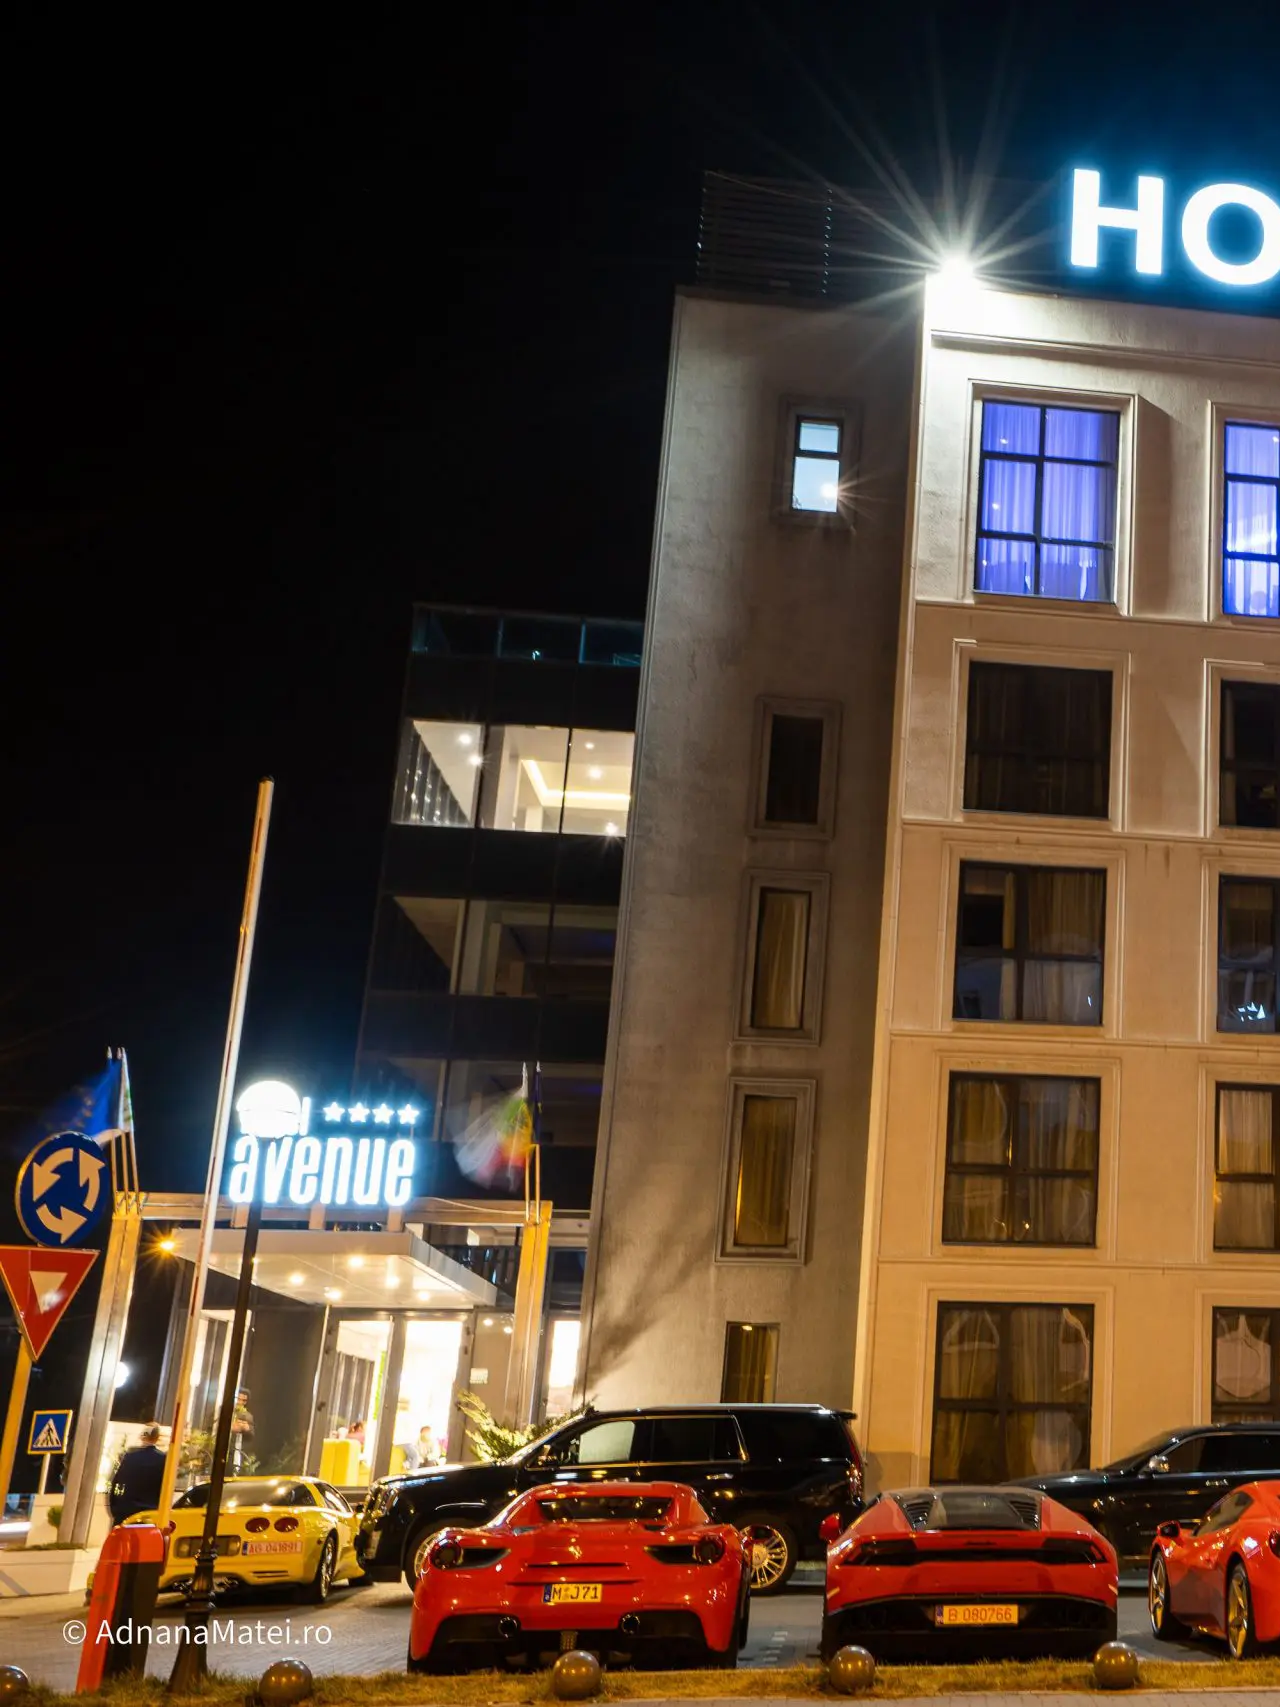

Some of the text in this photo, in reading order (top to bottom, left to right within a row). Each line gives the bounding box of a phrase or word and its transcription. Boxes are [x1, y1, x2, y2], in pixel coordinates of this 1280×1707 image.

[228, 1133, 416, 1207] avenue
[552, 1587, 562, 1600] M
[948, 1607, 1012, 1621] B 080766
